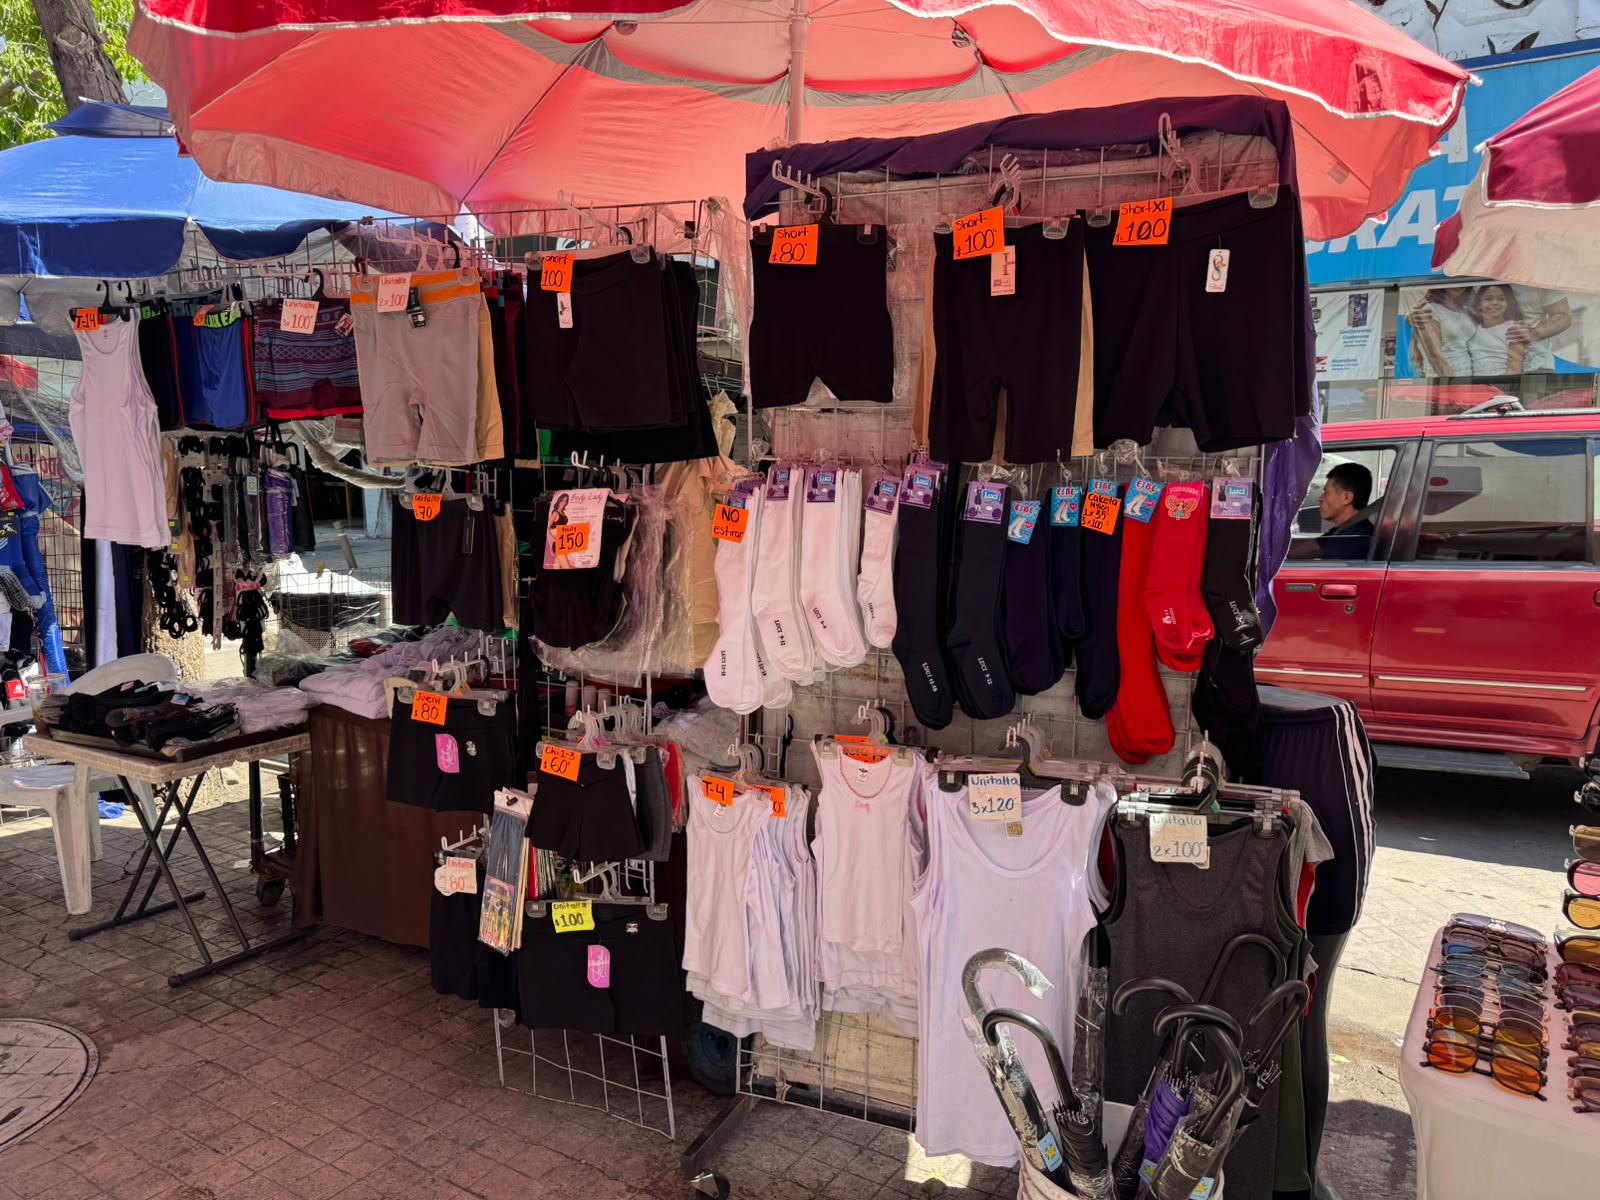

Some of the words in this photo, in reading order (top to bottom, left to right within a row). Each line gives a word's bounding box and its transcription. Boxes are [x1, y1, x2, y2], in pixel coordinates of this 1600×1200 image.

[955, 211, 987, 231] Short
[777, 226, 809, 239] Short
[541, 269, 564, 288] 100
[721, 506, 740, 523] NO
[558, 531, 585, 551] 150
[774, 619, 783, 633] LUCI
[921, 661, 932, 678] LUCI
[977, 656, 988, 672] LUCI
[970, 775, 1020, 786] Unitalla
[702, 779, 725, 801] T-4
